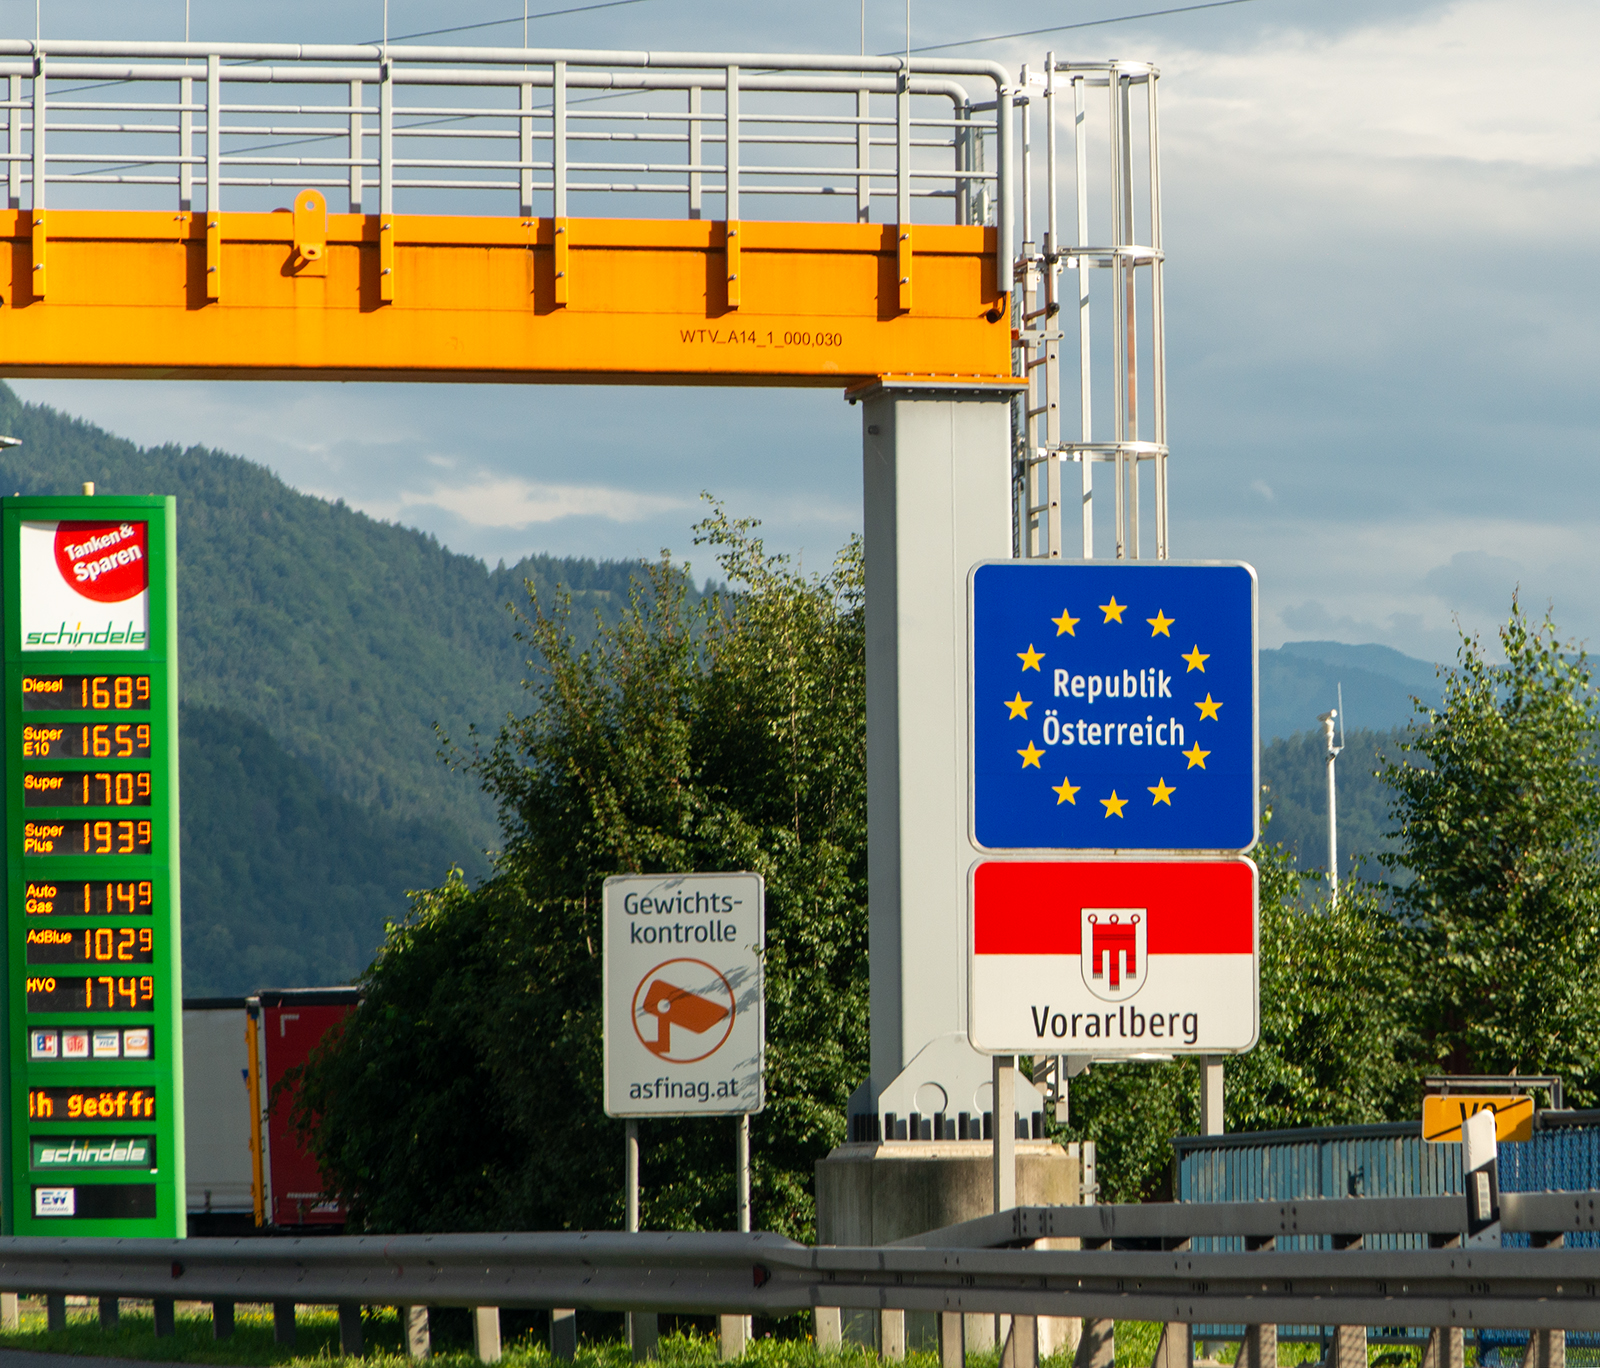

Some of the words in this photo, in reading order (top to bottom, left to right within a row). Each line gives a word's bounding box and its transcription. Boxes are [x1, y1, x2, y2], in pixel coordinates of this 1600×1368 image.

[73, 544, 143, 582] Sparen
[26, 621, 146, 645] schindele
[22, 677, 64, 693] Diesel
[1053, 667, 1172, 704] Republik
[23, 726, 64, 743] Super
[1042, 709, 1185, 746] Österreich
[23, 741, 51, 757] E10
[23, 774, 64, 792] Super
[24, 822, 65, 838] Super
[24, 837, 54, 854] Plus
[26, 883, 58, 899] Auto
[25, 898, 54, 914] Gas
[624, 890, 743, 915] Gewichts-
[26, 928, 73, 945] AdBlue
[630, 919, 737, 944] kontrolle
[26, 977, 57, 994] HVO
[1031, 1005, 1198, 1045] Vorarlberg
[629, 1076, 739, 1102] asfinag.at
[40, 1139, 146, 1163] schindele
